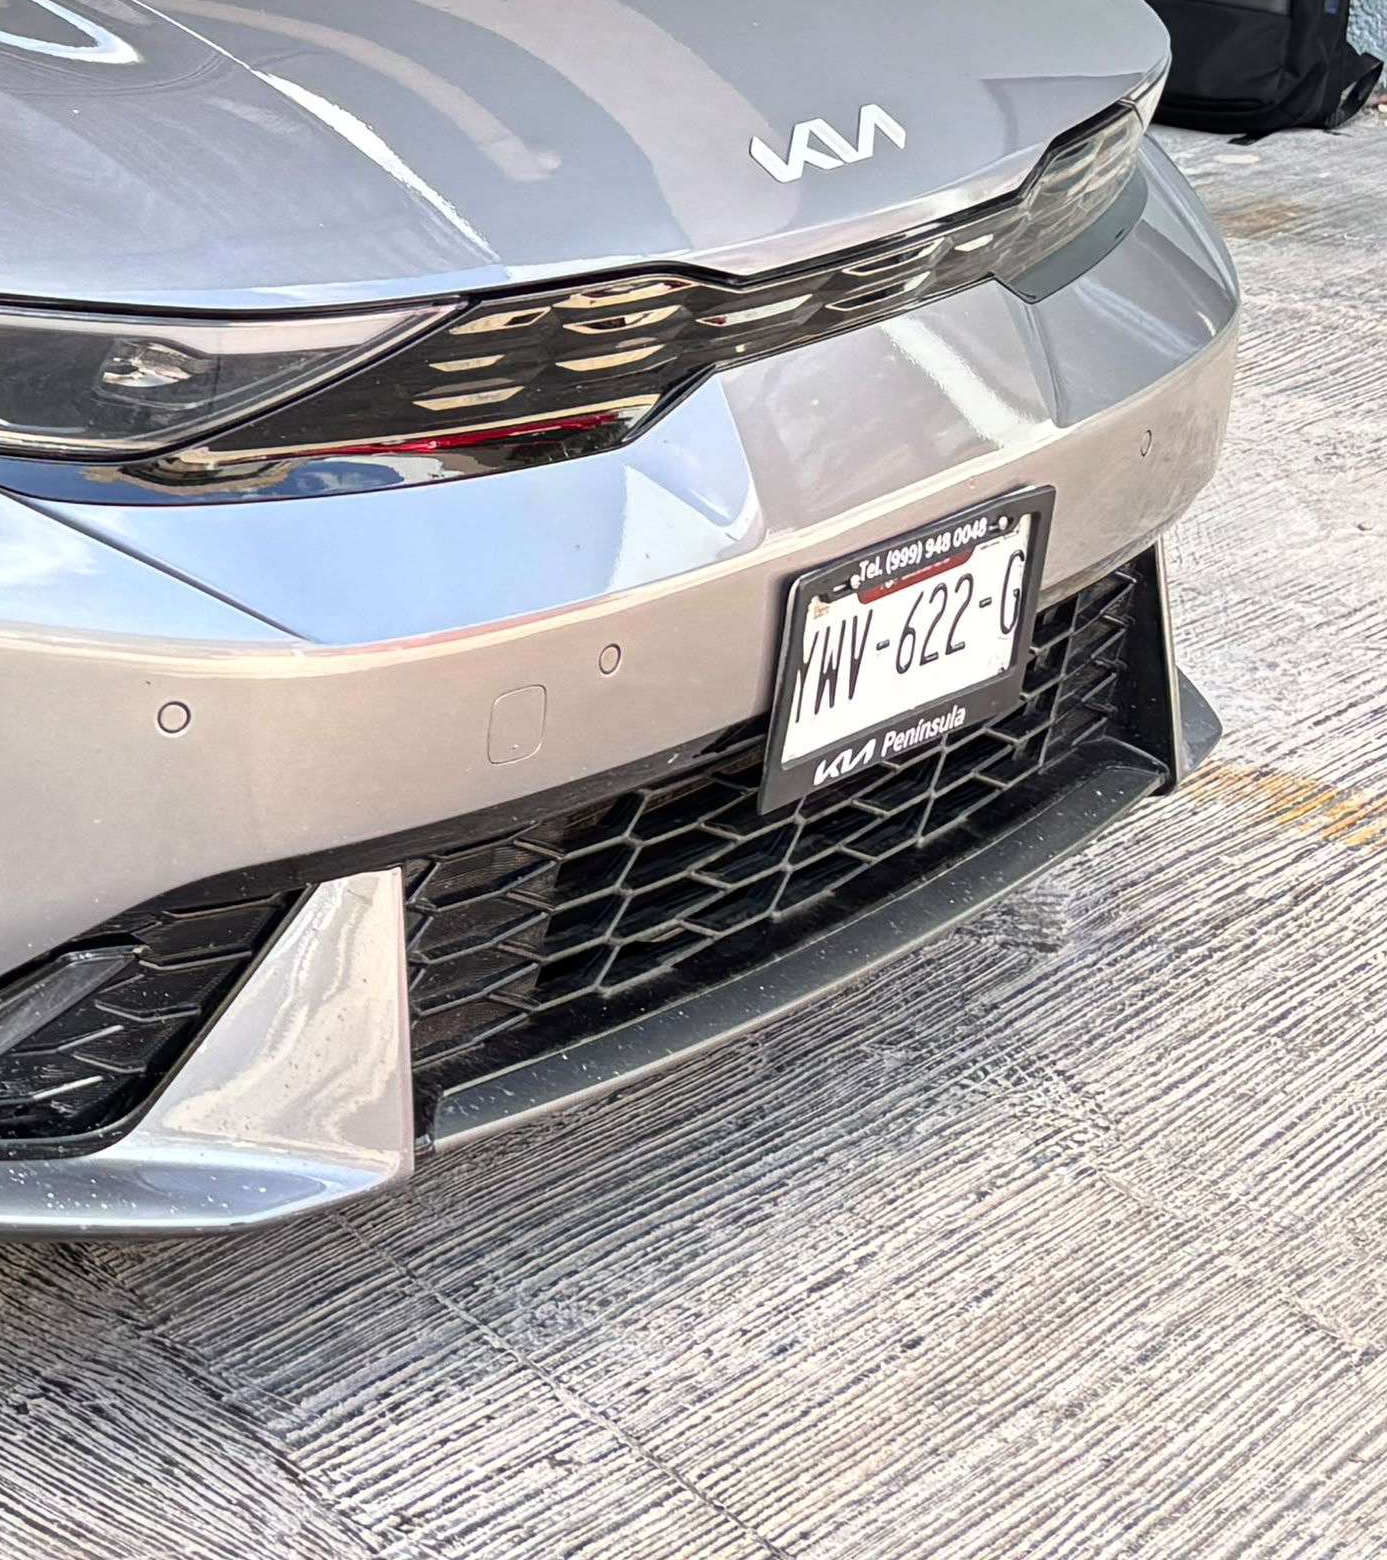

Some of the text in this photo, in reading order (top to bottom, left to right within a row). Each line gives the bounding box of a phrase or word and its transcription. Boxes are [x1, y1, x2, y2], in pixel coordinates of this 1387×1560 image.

[748, 104, 907, 183] KIA
[859, 557, 883, 582] Tel.
[885, 541, 925, 575] (999)
[925, 530, 952, 558] 948
[952, 516, 988, 548] 0048
[794, 548, 1026, 724] YWV-622-G
[813, 704, 967, 787] KIA Península
